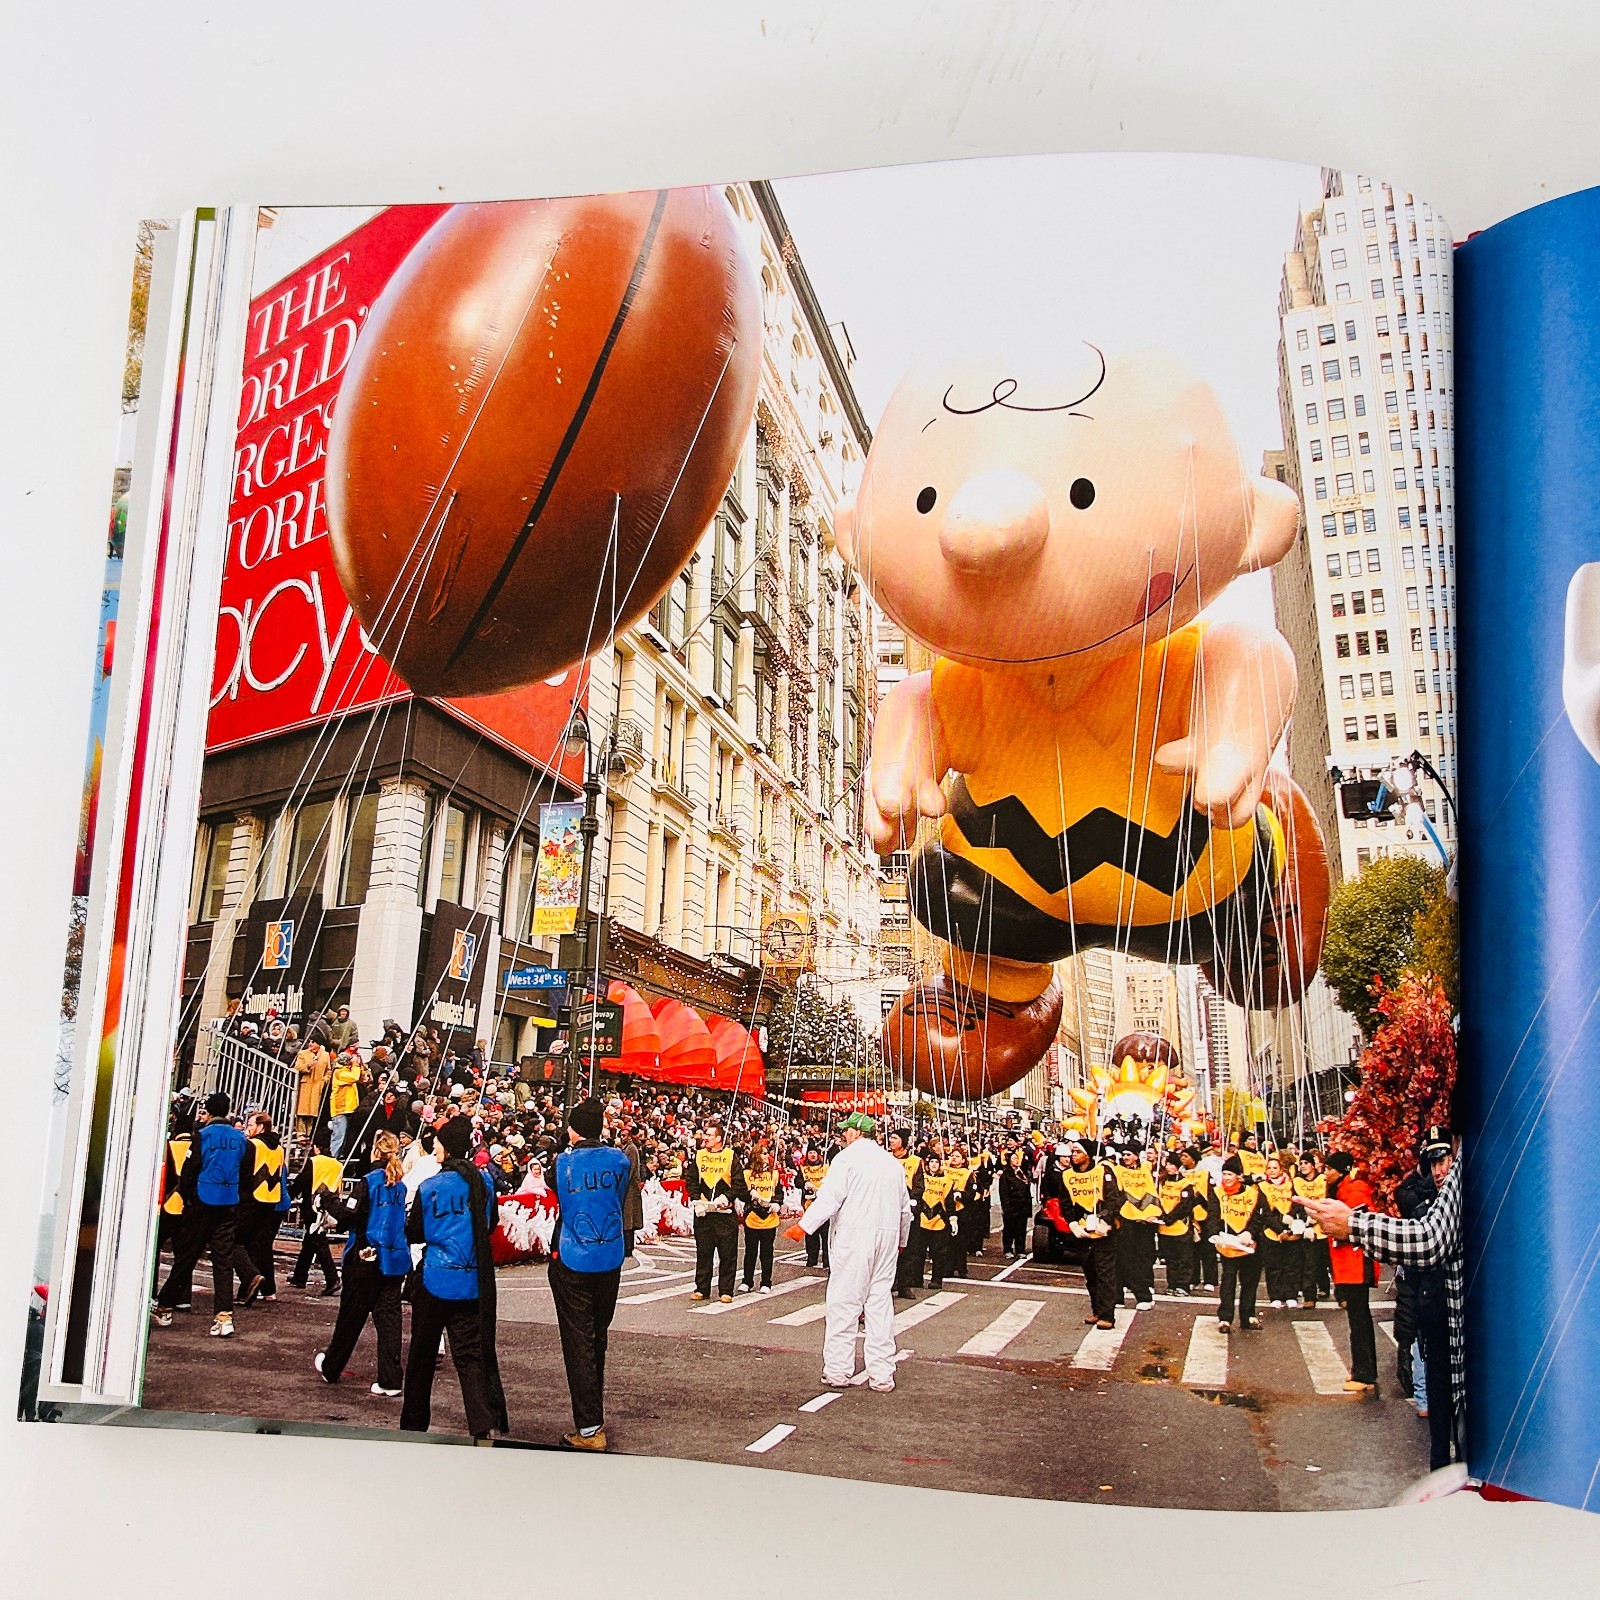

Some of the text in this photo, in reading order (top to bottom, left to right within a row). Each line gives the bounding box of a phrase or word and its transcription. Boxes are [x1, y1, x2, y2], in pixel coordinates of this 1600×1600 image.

[253, 251, 350, 360] THE
[509, 974, 532, 986] West
[533, 972, 552, 986] 34th
[245, 984, 304, 1021] Sunglass Hut
[462, 998, 477, 1029] Hut
[700, 1165, 724, 1174] Brown
[1068, 1175, 1099, 1185] Charlie
[926, 1188, 944, 1197] rown
[1071, 1187, 1101, 1197] Brown
[1221, 1194, 1253, 1206] Charlie
[1222, 1205, 1252, 1217] Brown
